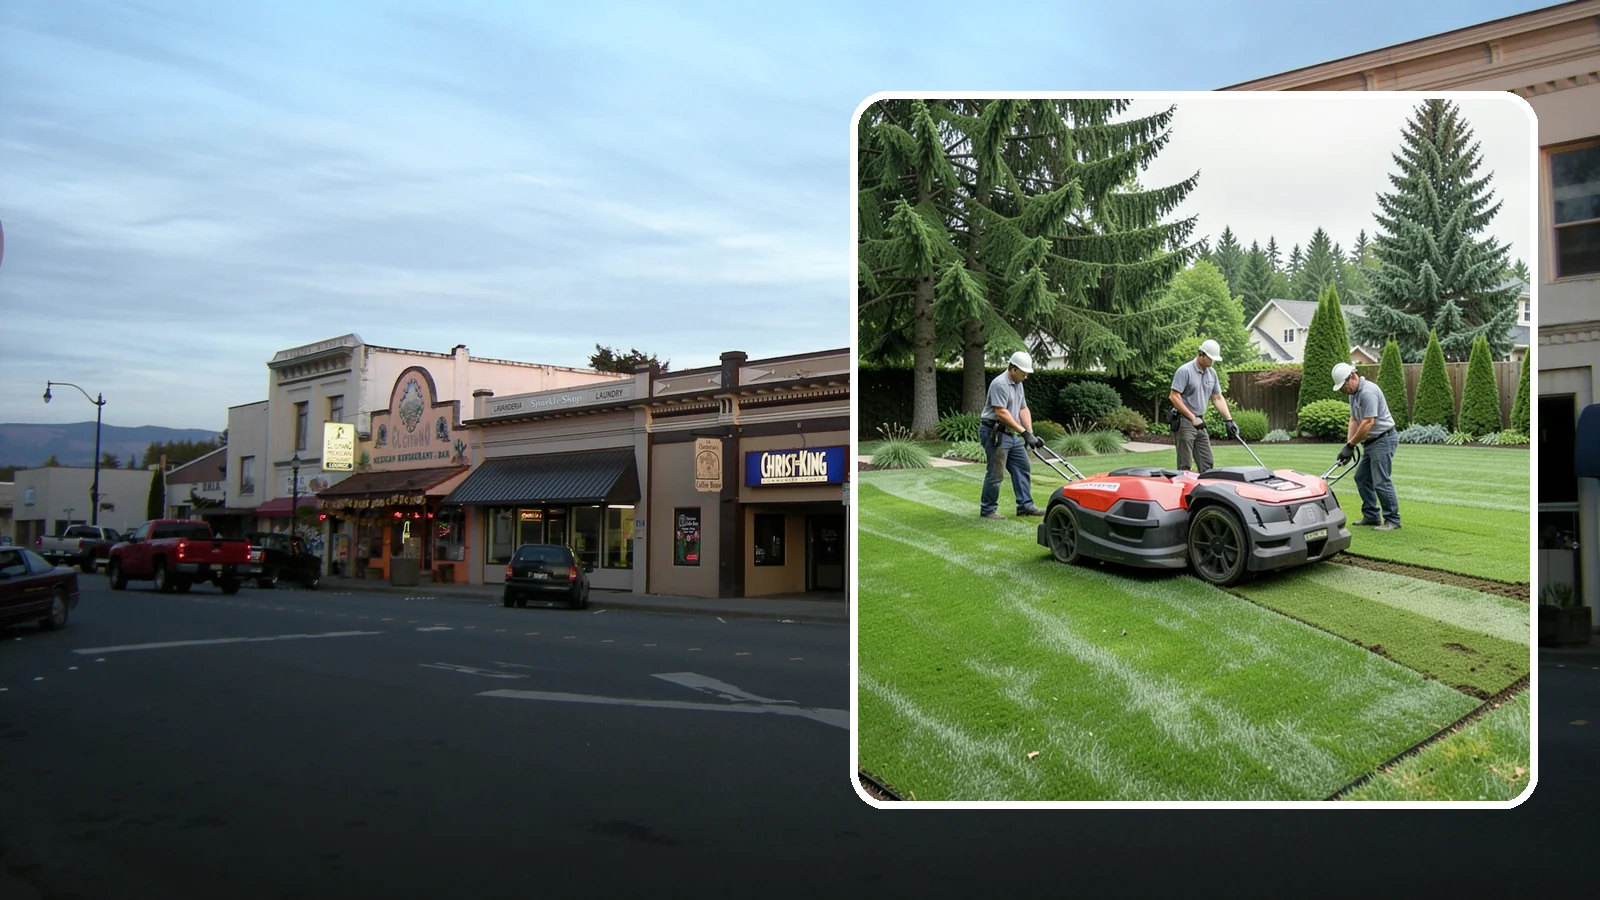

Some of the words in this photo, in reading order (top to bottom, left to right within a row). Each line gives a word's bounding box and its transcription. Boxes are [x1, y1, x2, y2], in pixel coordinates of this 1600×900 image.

[494, 402, 523, 412] LAVANDERIA
[562, 394, 582, 405] Shop
[595, 389, 624, 400] LAUNDRY
[373, 454, 396, 464] MEXICAN
[397, 451, 433, 463] RESTAURANT
[438, 449, 450, 459] BAR
[761, 452, 797, 478] CHRIST
[799, 449, 827, 476] KING
[696, 480, 709, 489] Coffee
